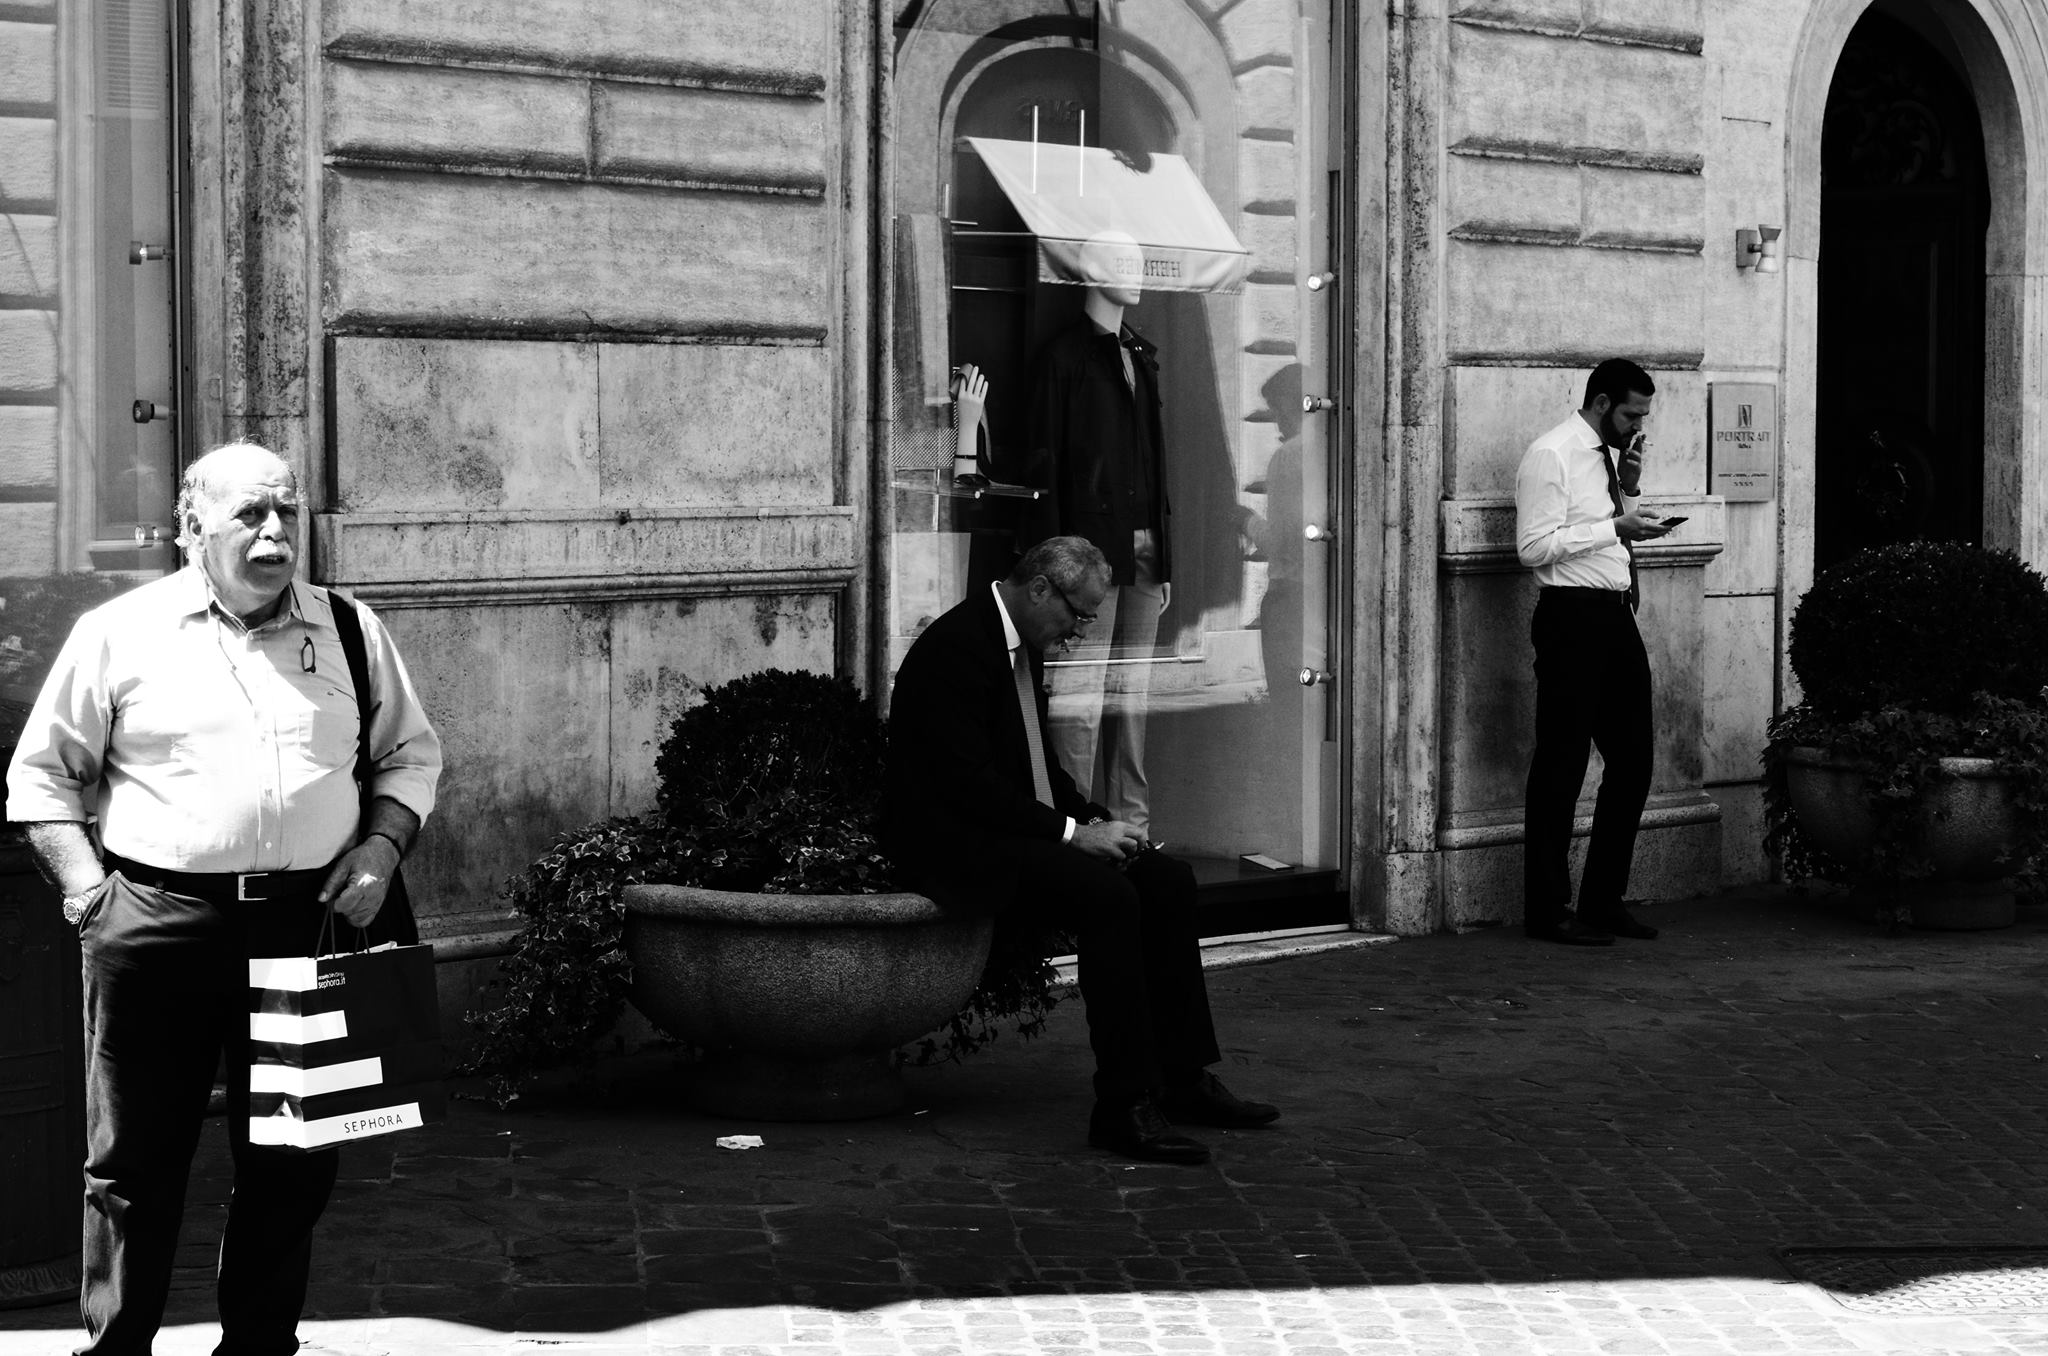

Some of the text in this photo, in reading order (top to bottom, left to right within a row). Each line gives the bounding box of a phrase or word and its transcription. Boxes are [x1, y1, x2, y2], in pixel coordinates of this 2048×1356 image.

[1716, 431, 1770, 442] PORTRAIT
[318, 977, 346, 989] sephora.it
[344, 1114, 403, 1133] SEPHORA
